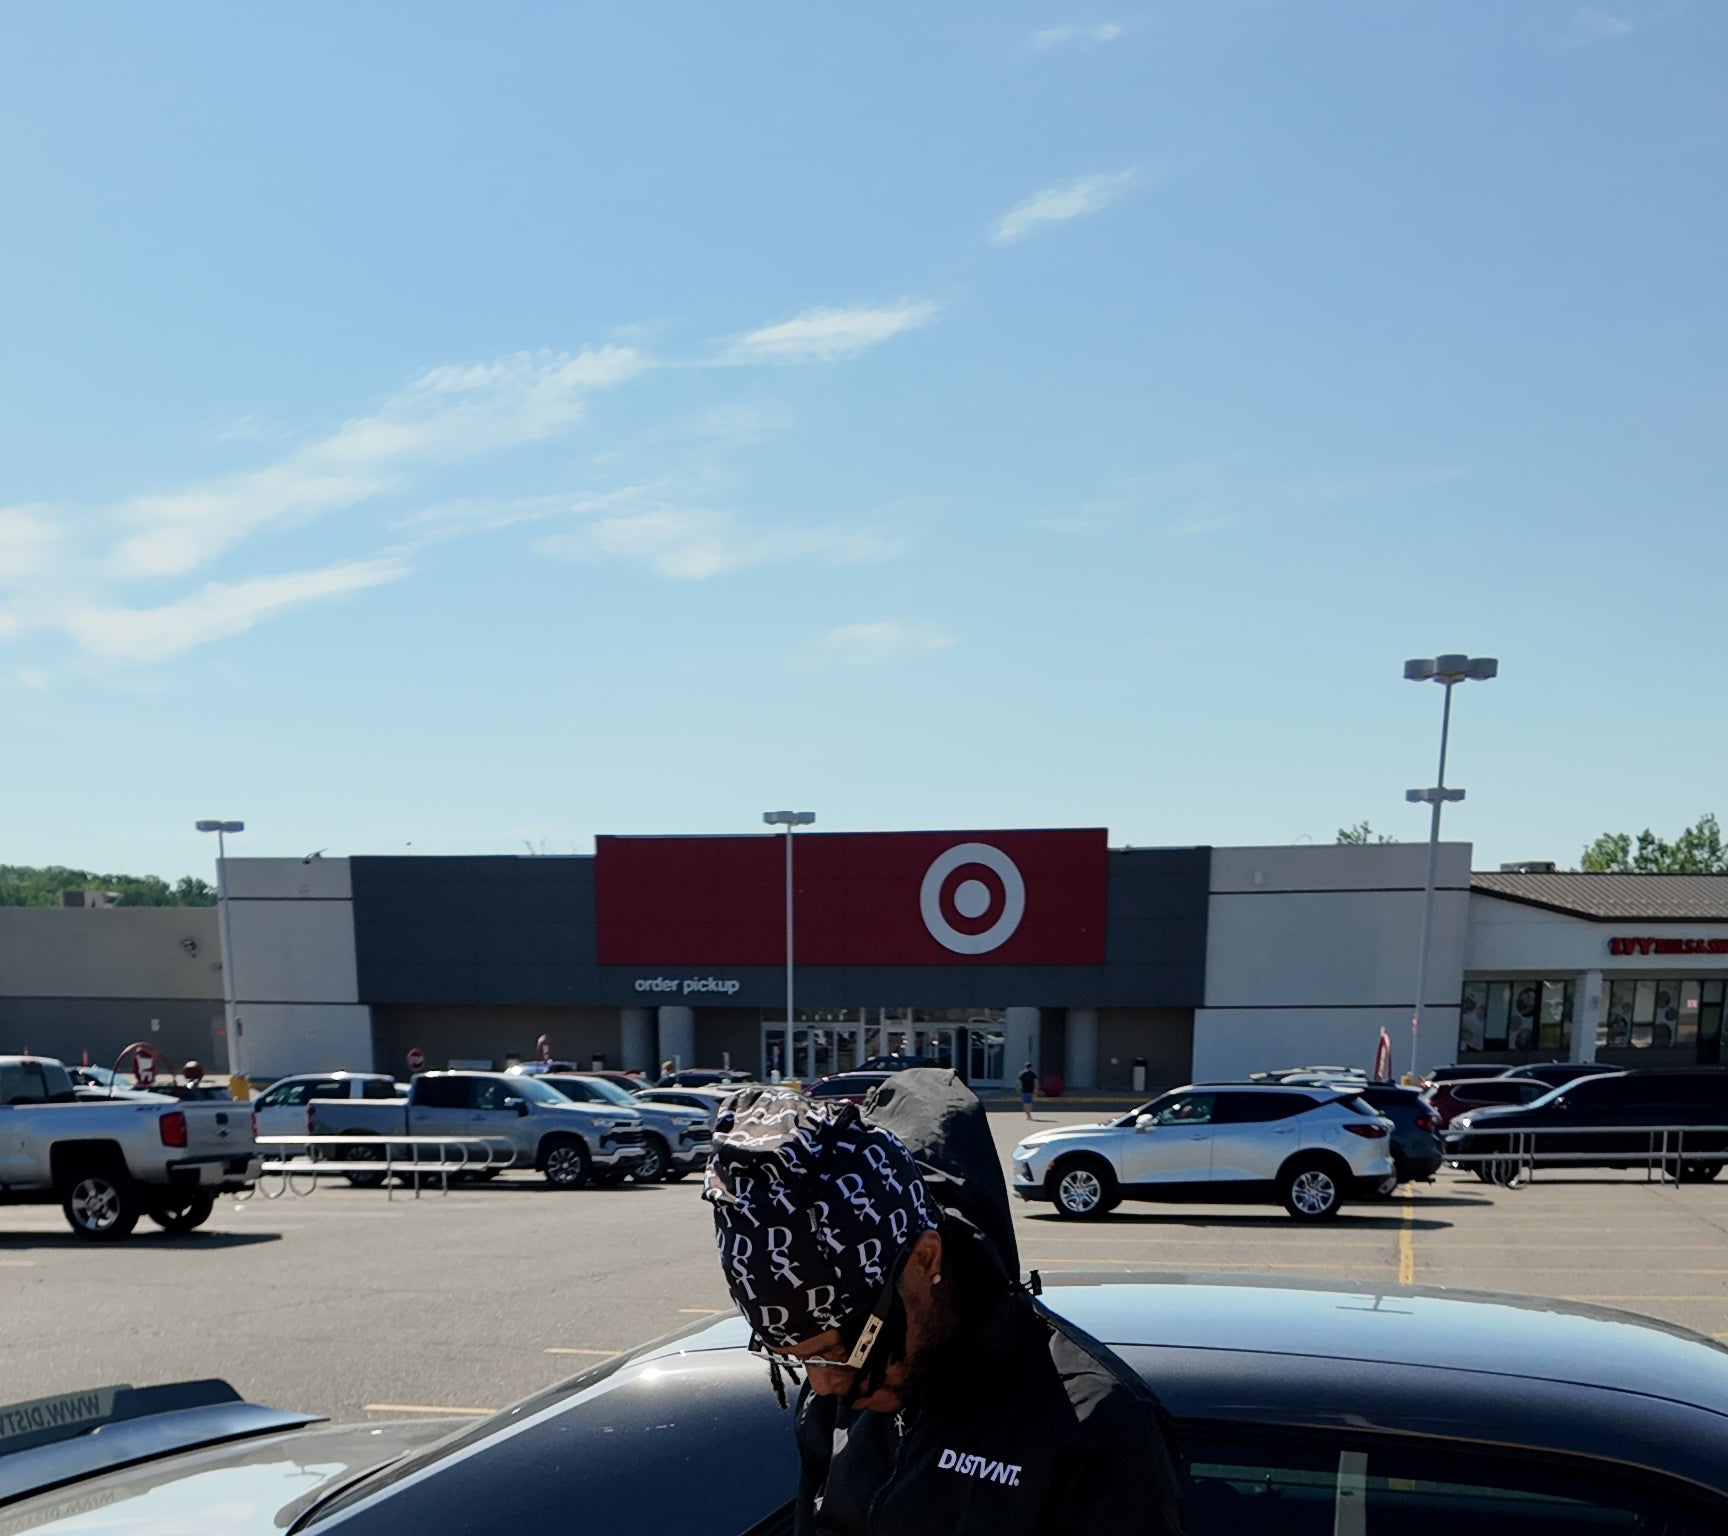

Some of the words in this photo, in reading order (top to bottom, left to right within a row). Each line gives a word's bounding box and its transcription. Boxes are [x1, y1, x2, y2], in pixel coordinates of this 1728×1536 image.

[634, 976, 679, 992] order
[683, 976, 740, 996] pickup
[731, 1233, 758, 1301] DST
[766, 1225, 804, 1290] DST
